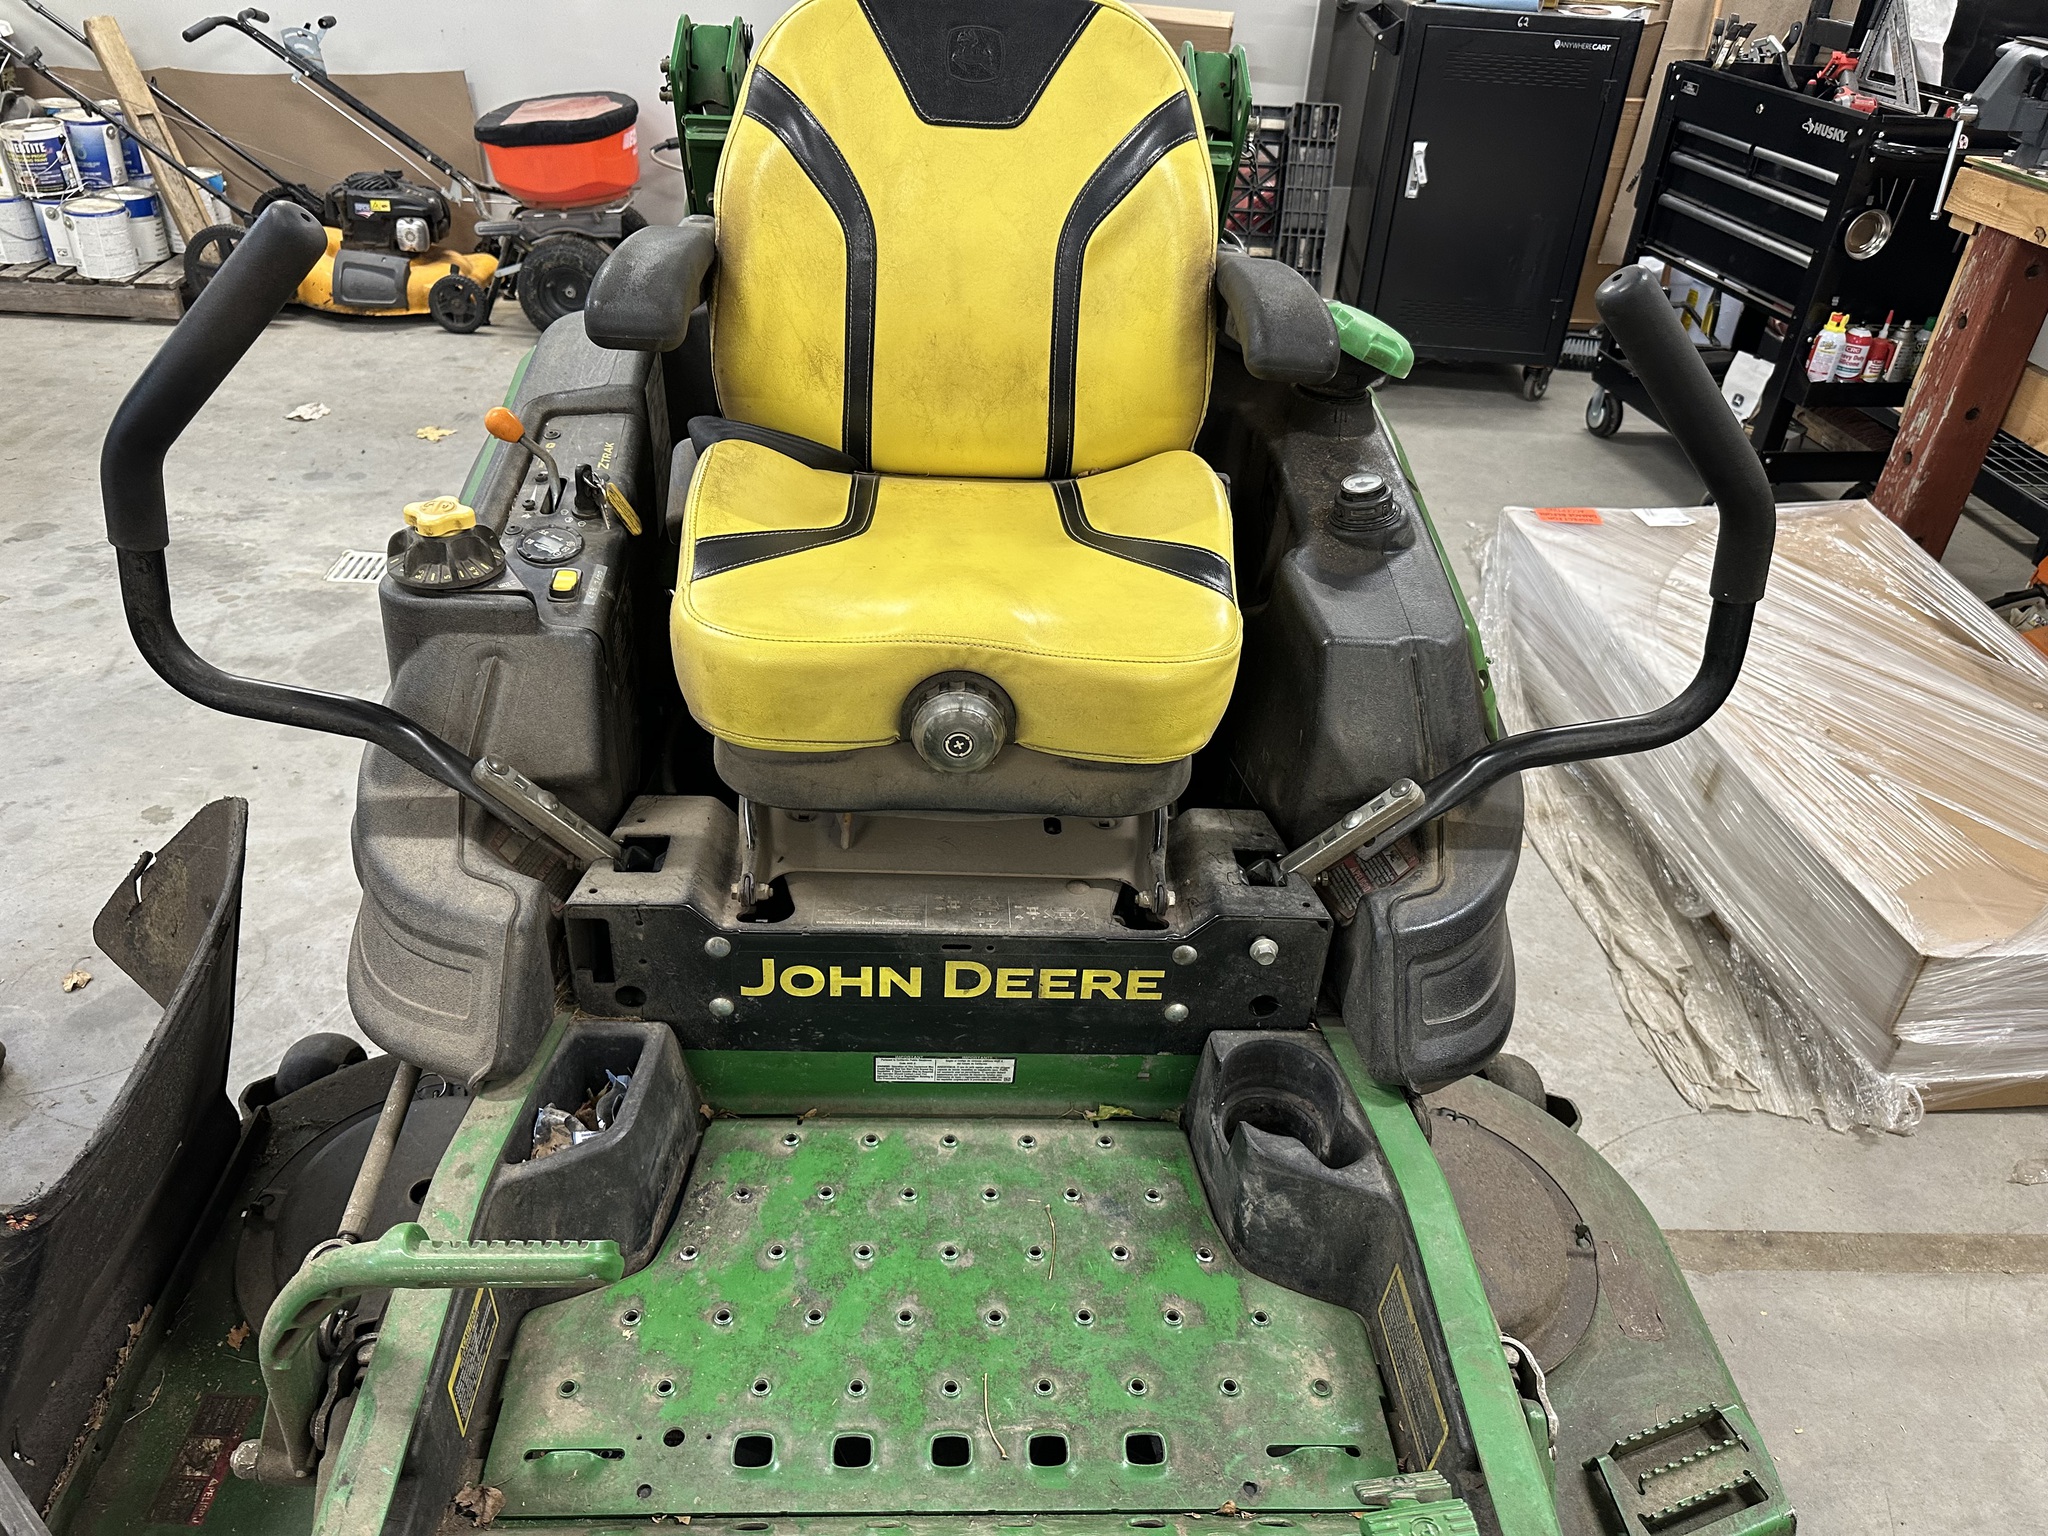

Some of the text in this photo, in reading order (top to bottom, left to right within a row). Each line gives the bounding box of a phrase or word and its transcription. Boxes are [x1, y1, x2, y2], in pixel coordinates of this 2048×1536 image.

[1517, 16, 1529, 27] 62
[1560, 41, 1611, 52] ANYWHERECART
[1813, 121, 1848, 143] HUSKY
[597, 442, 615, 470] ZTRAK
[740, 958, 1166, 1001] JOHN DEERE
